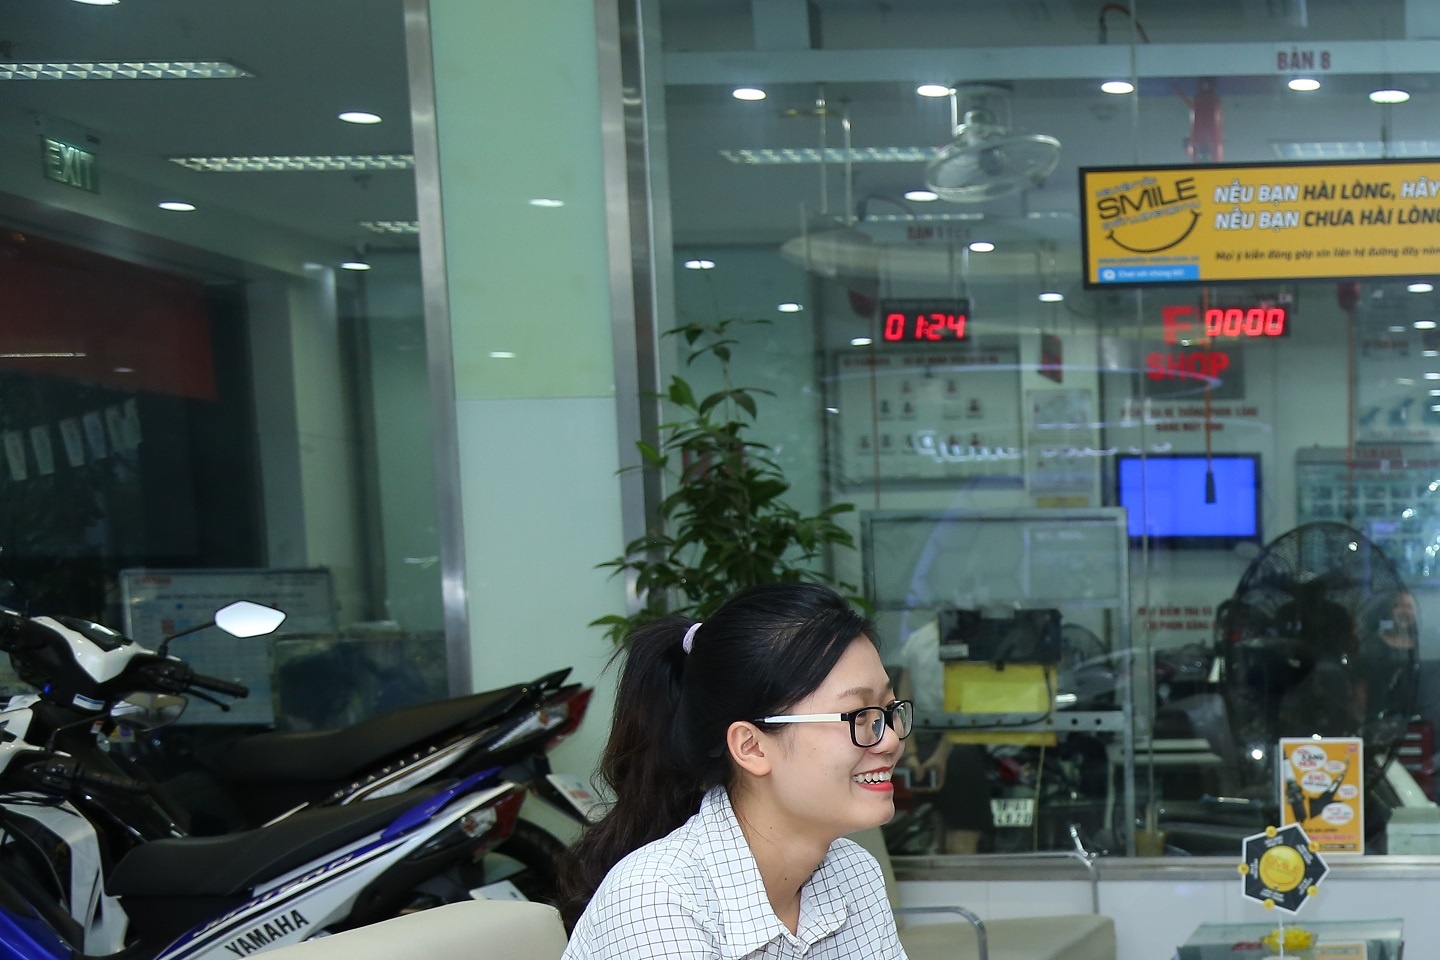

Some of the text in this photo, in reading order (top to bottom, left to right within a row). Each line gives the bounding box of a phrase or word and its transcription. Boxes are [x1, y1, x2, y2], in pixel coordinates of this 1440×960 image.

[1321, 51, 1331, 71] 8
[46, 138, 94, 190] EXIT
[1097, 178, 1198, 219] SMILE
[1213, 178, 1255, 203] NẾU
[1257, 184, 1299, 206] BẠN
[1303, 180, 1335, 200] HÀI
[1341, 179, 1396, 201] LÒNG,
[1401, 176, 1440, 198] HÃY
[1214, 205, 1256, 230] NẾU
[1258, 210, 1300, 232] BẠN
[1304, 207, 1354, 228] CHƯA
[1360, 204, 1393, 226] HÀI
[884, 313, 966, 341] 01:24
[1146, 352, 1230, 380] SHOP
[225, 909, 310, 957] YAMAHA
